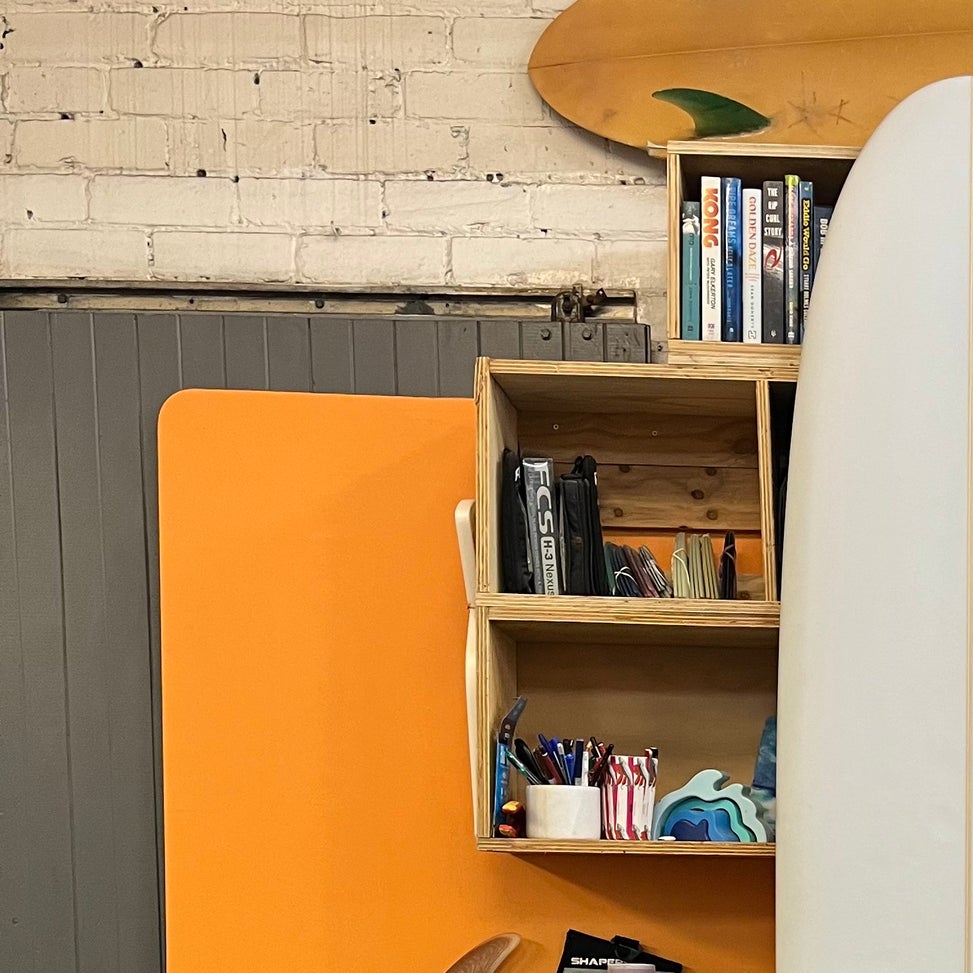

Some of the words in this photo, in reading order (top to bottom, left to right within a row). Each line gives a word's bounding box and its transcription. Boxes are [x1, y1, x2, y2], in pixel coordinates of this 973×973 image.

[768, 188, 778, 196] THE
[703, 188, 719, 248] KONG
[768, 202, 777, 210] RIP
[802, 200, 810, 226] Eddie
[748, 196, 756, 242] GOLDEN
[766, 215, 780, 223] CURL
[764, 228, 782, 236] STORY
[802, 228, 810, 256] Would
[748, 244, 756, 269] DAZE
[802, 257, 810, 270] Go
[534, 461, 554, 534] FCS
[543, 540, 553, 560] H-3
[545, 564, 554, 596] Nexus
